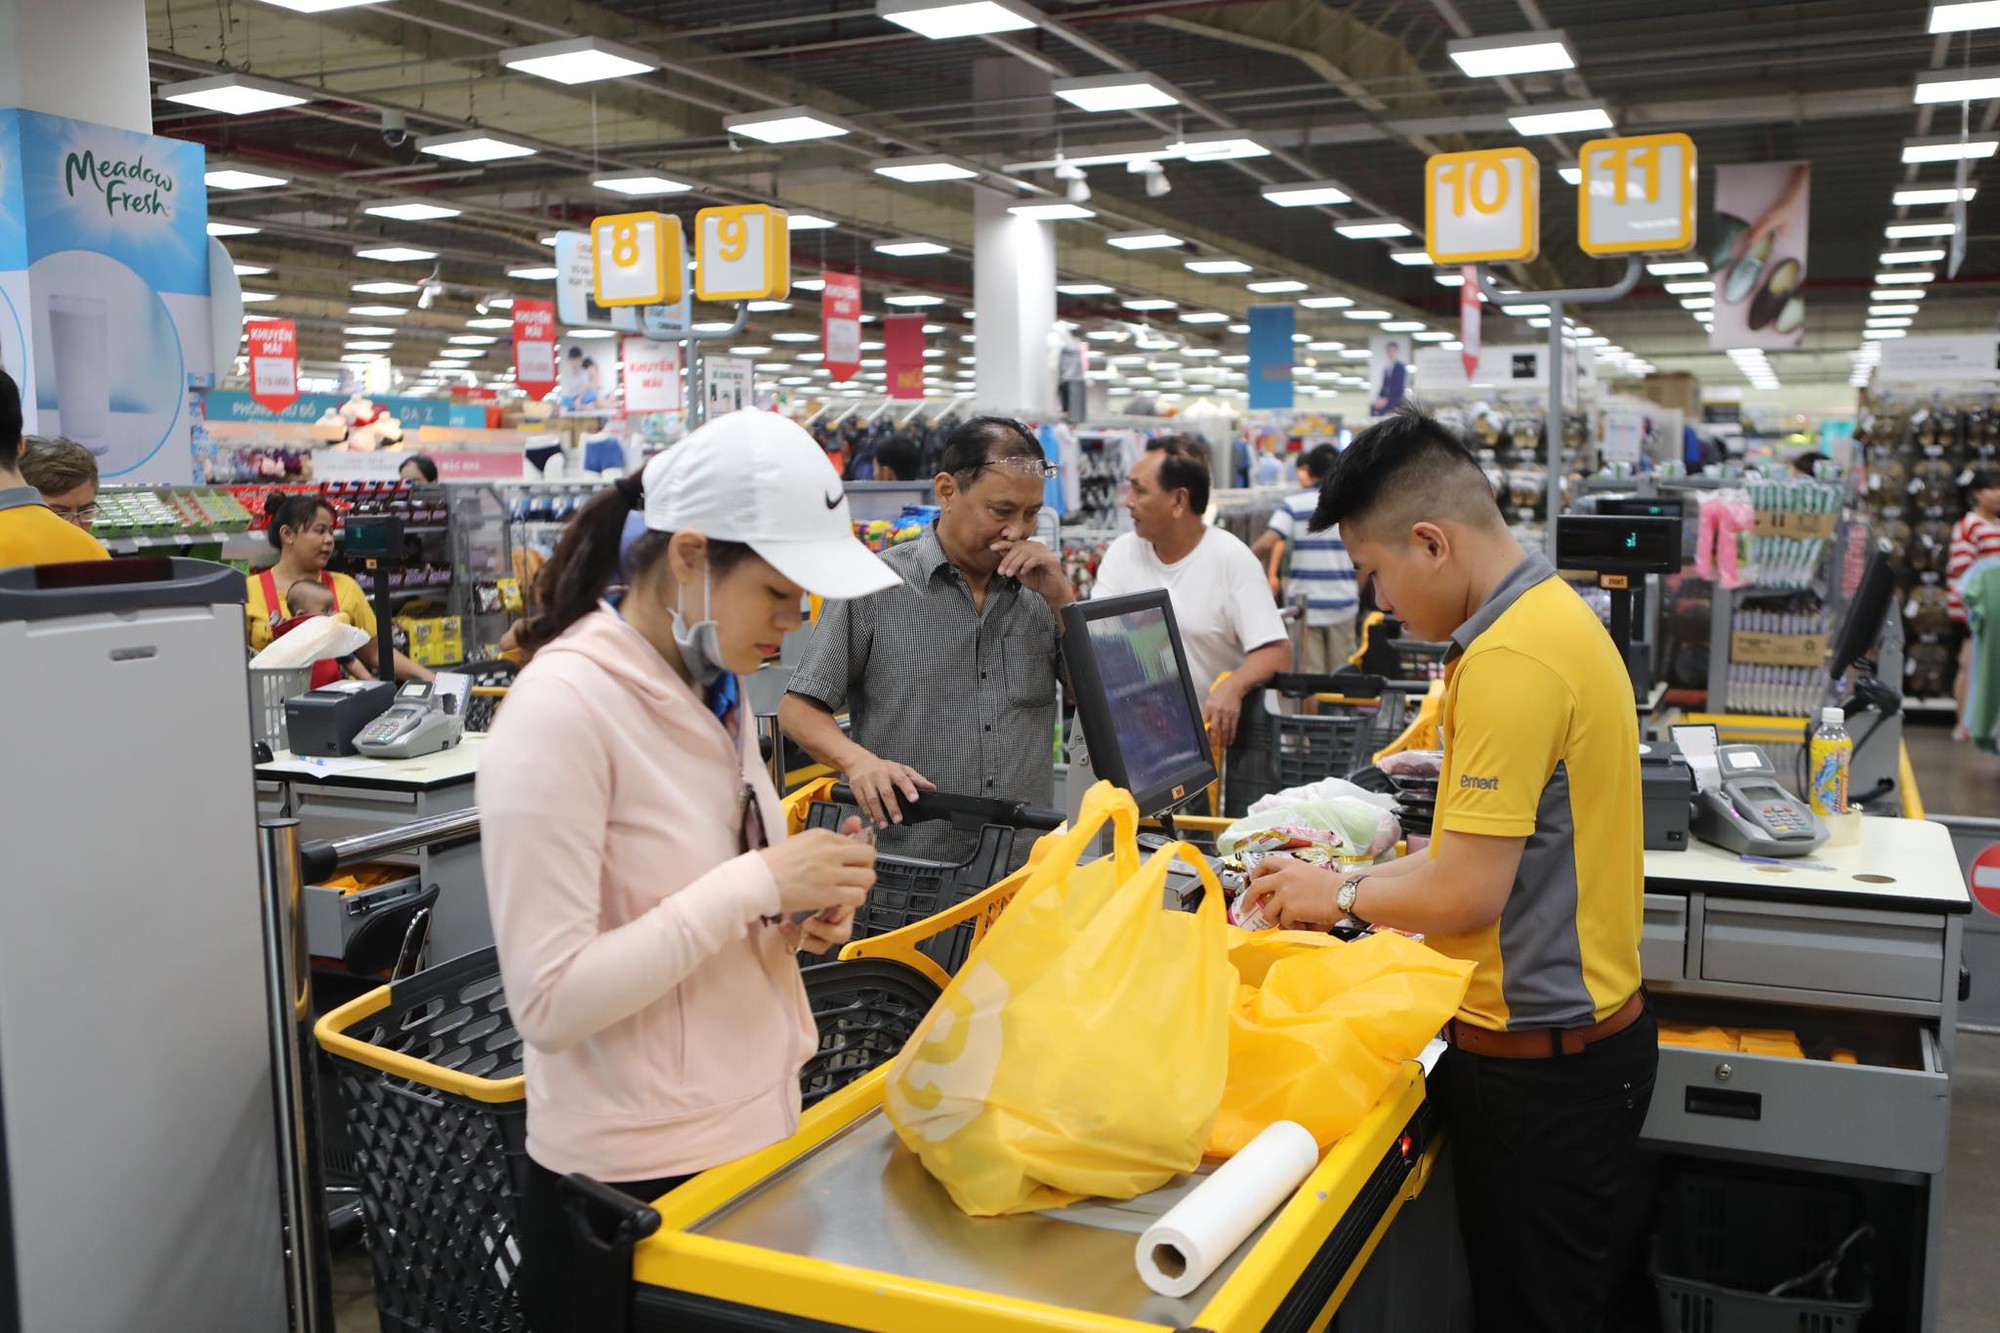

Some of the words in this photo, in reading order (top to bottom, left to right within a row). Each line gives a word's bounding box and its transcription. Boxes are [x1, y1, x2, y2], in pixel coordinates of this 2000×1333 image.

[65, 150, 172, 197] Meadow
[1439, 160, 1510, 217] 10
[1600, 147, 1660, 205] 11
[106, 180, 169, 216] Fresh
[612, 221, 639, 267] 8
[717, 212, 747, 262] 9
[1460, 774, 1500, 791] emart
